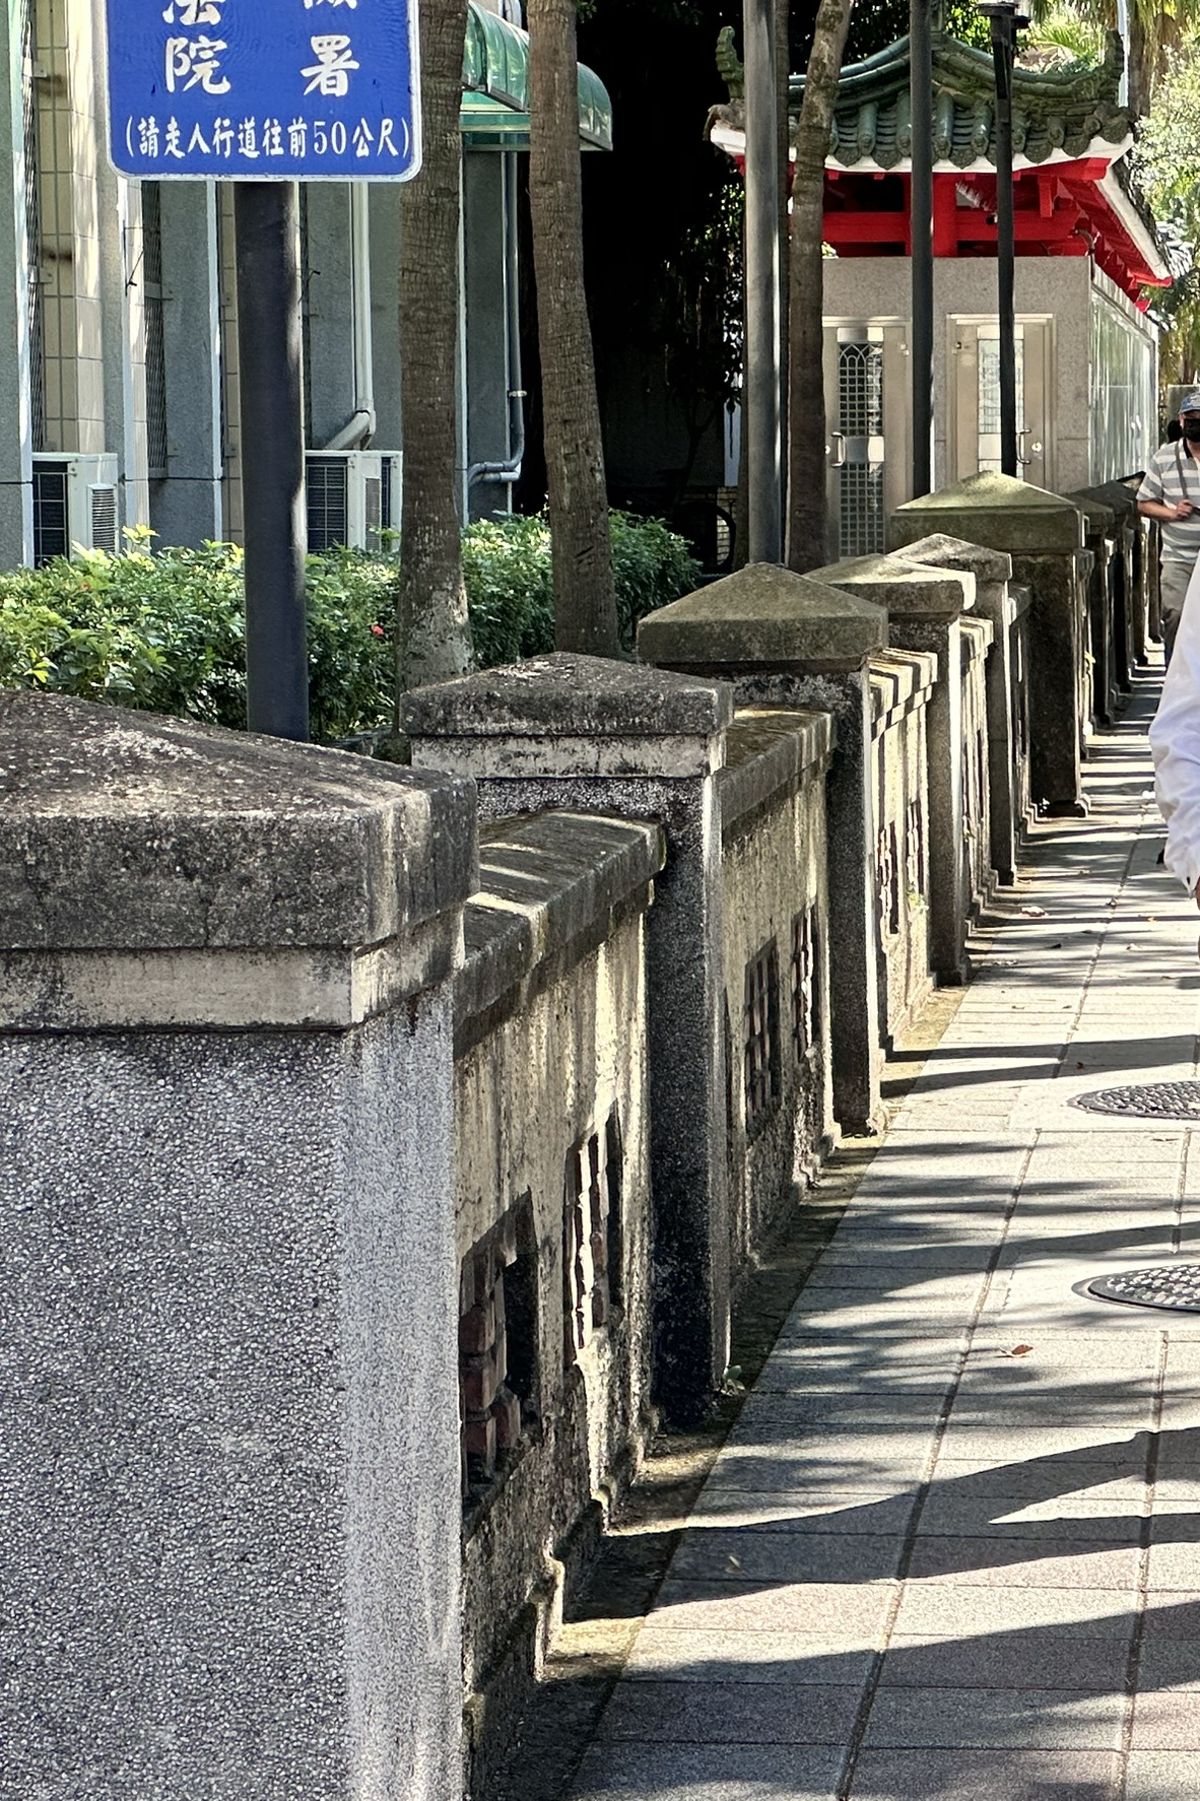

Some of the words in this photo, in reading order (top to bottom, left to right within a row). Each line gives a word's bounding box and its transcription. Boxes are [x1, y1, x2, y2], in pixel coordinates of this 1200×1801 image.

[126, 115, 409, 159] (請走人行道往前50公尺)
